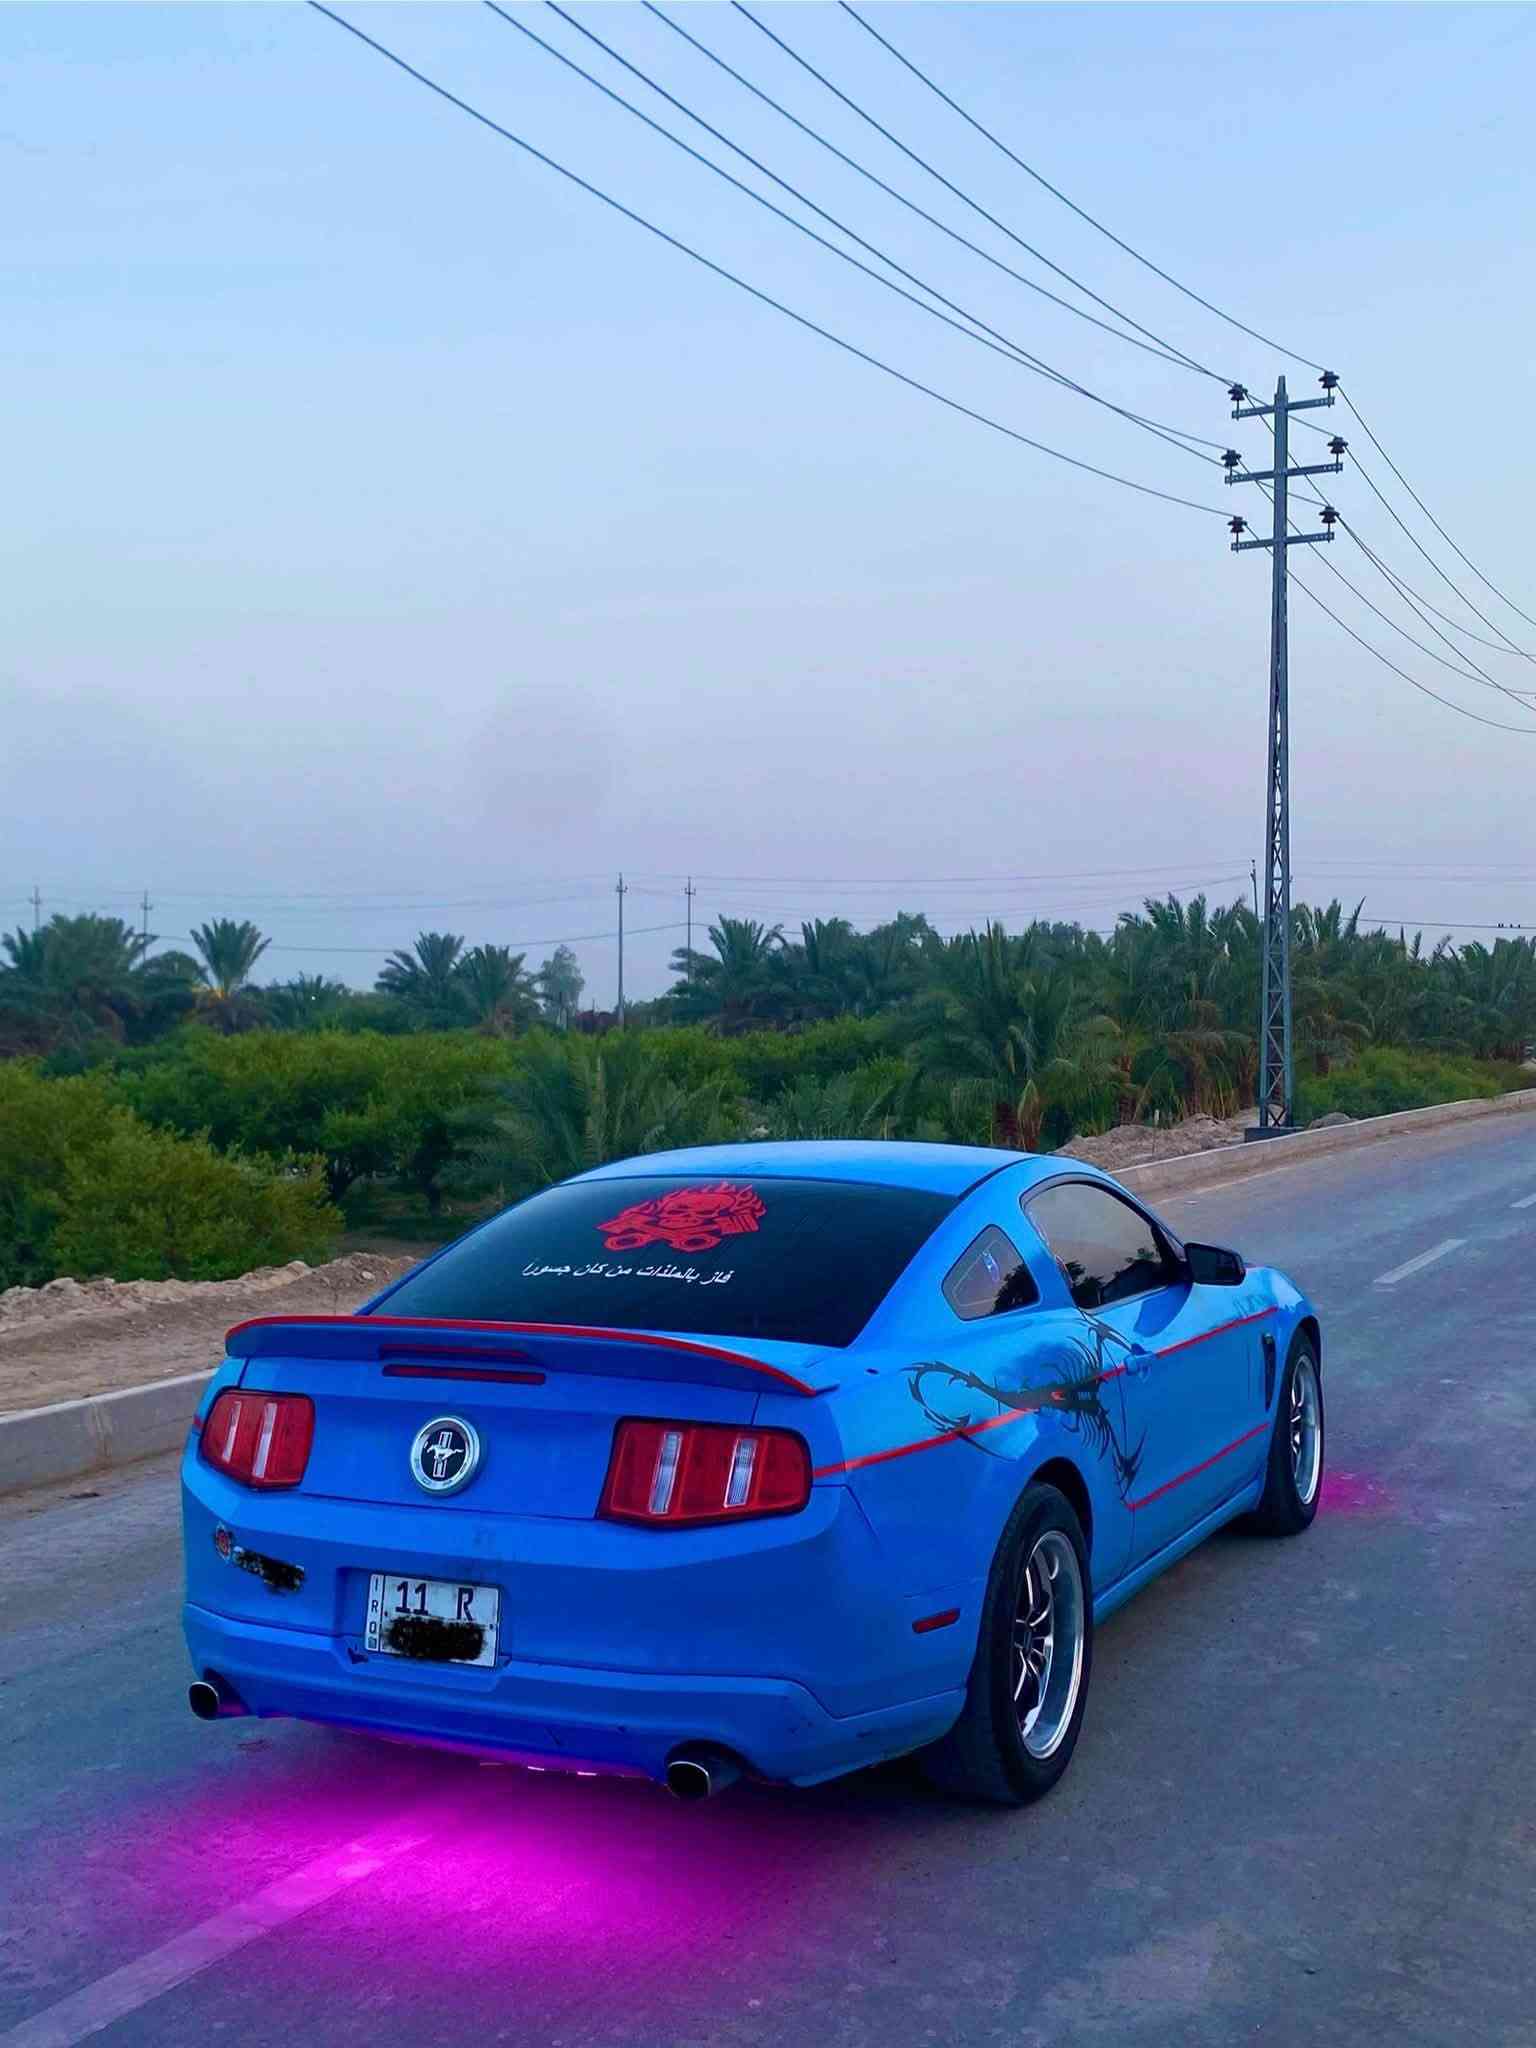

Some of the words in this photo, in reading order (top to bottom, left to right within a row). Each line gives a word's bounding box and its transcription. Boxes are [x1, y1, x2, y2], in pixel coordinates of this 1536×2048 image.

[572, 1262, 609, 1277] كان
[604, 1264, 633, 1278] من
[699, 1269, 735, 1285] فاز
[395, 1580, 430, 1616] 11
[456, 1587, 476, 1621] R
